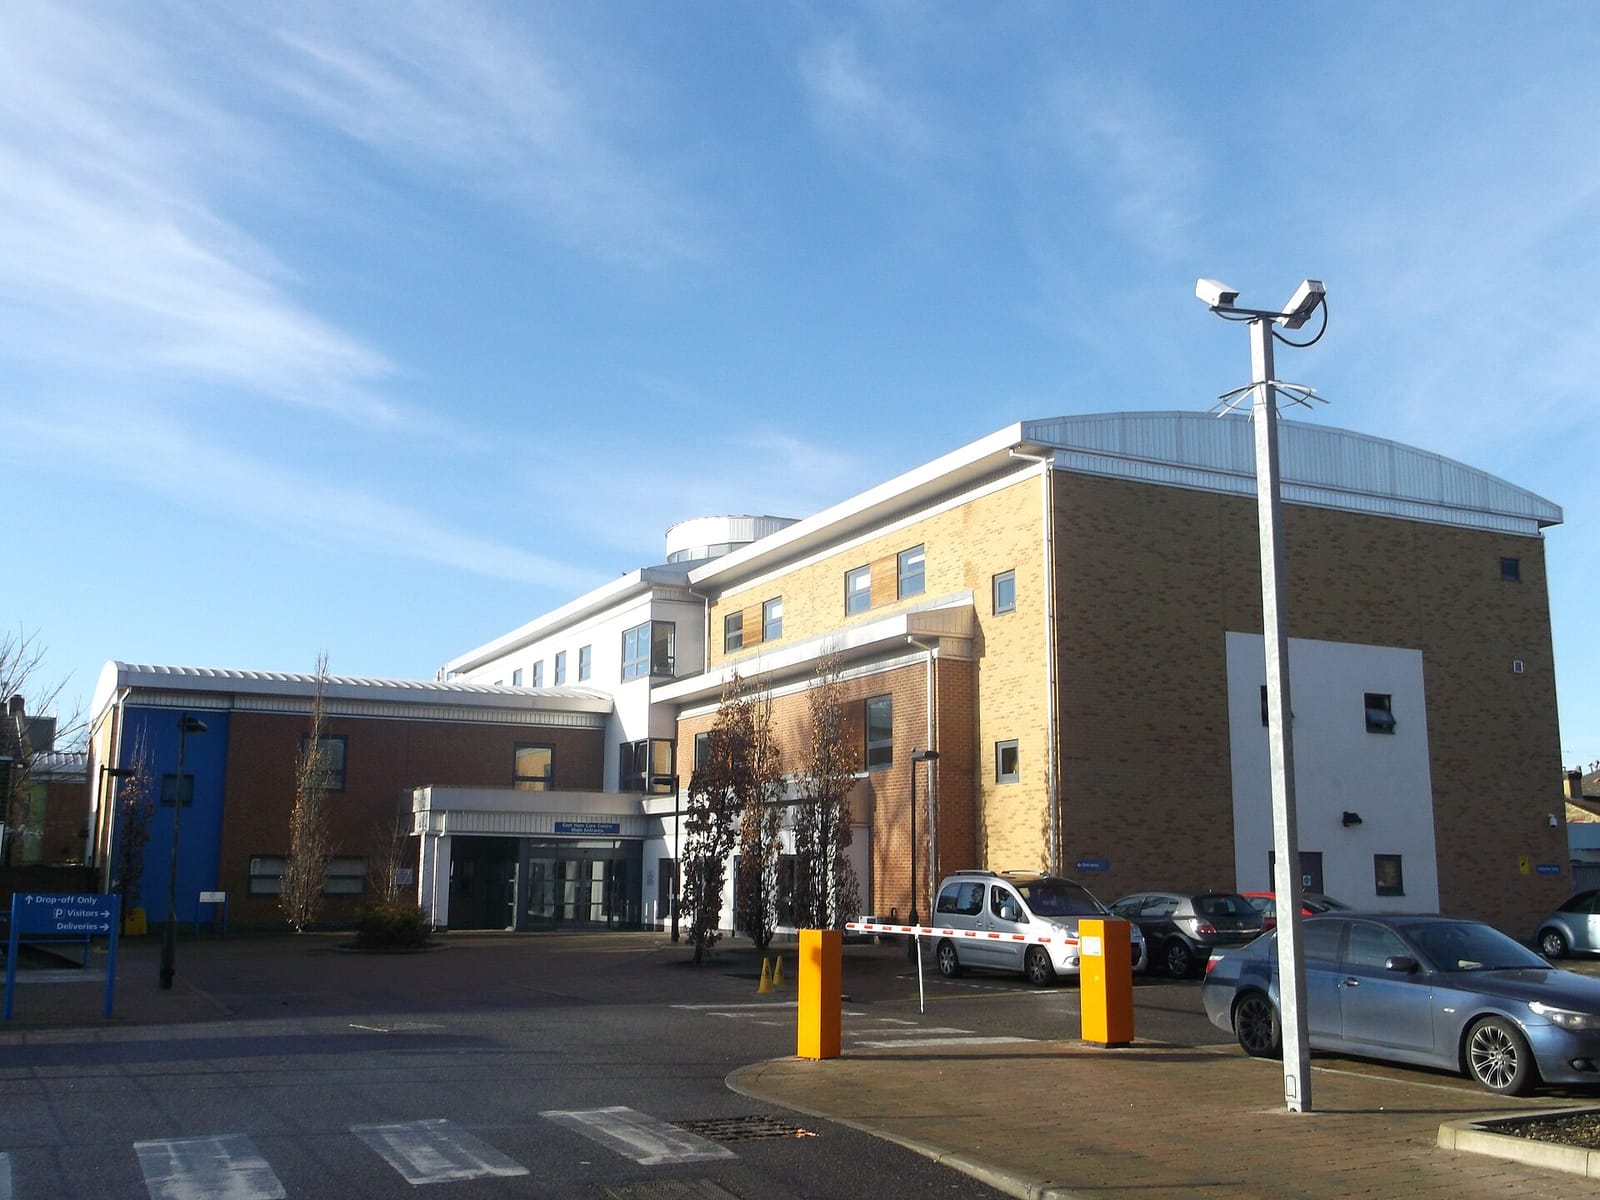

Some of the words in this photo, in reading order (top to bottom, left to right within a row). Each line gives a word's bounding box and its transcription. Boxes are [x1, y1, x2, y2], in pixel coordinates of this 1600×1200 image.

[35, 896, 74, 905] Drop-off
[77, 896, 97, 905] Only
[55, 908, 63, 918] P
[67, 909, 98, 918] Visitors
[56, 922, 98, 930] Deliveries
